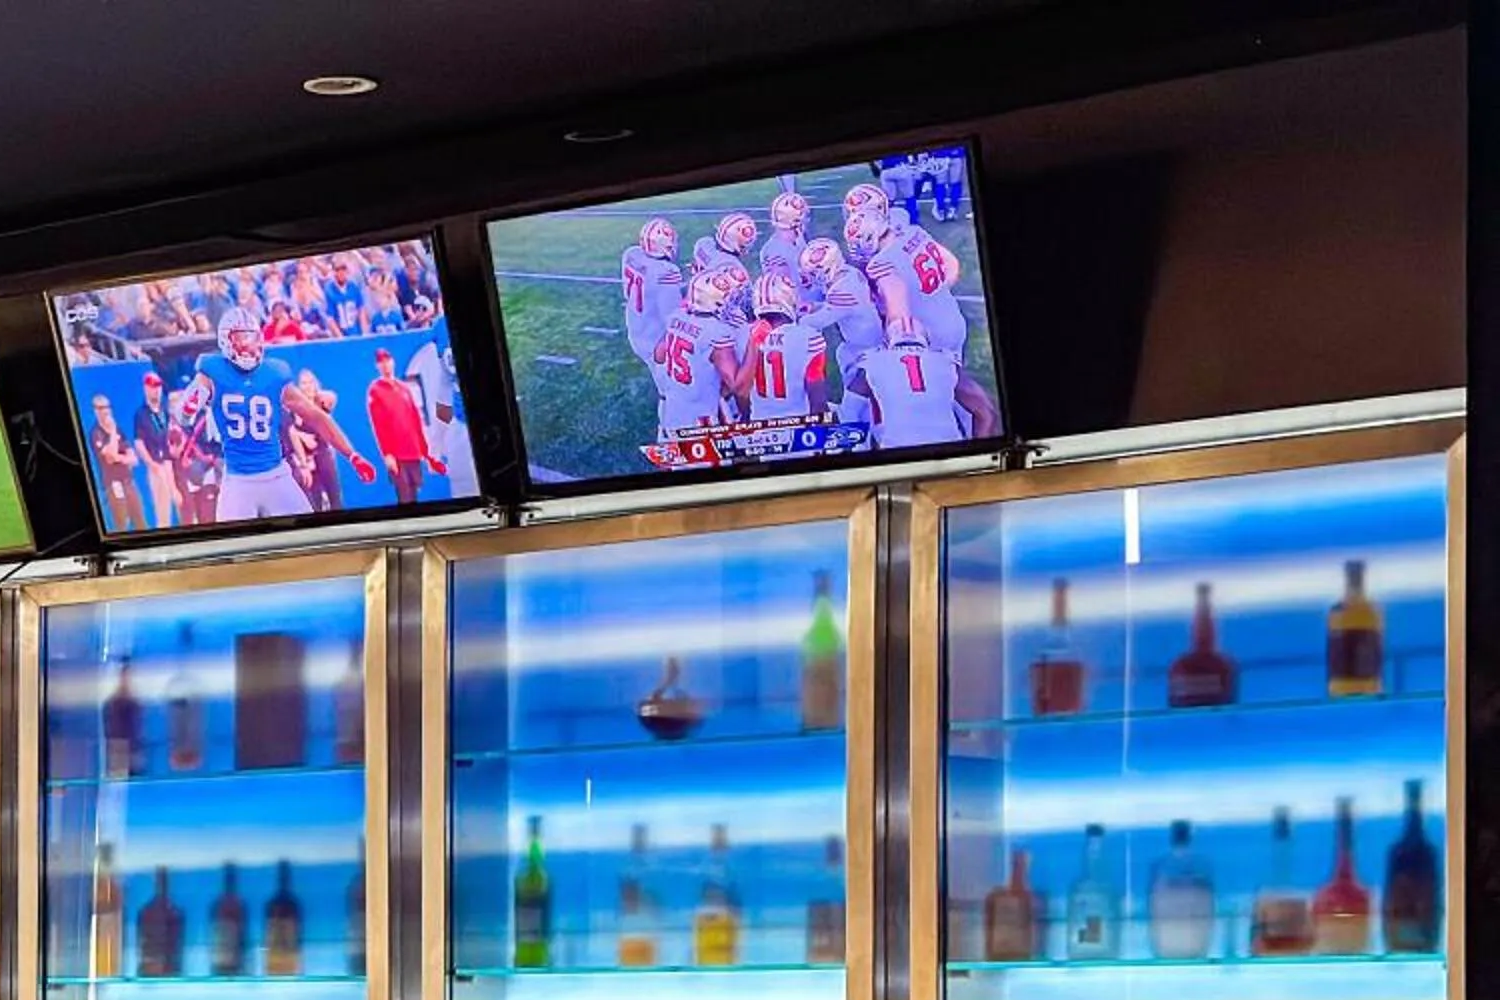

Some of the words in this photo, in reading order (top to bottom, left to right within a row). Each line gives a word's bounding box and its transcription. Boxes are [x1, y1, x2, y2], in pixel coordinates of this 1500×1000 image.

[666, 332, 695, 385] 15
[900, 354, 926, 393] 1
[221, 393, 274, 441] 58
[691, 443, 706, 458] 0
[801, 431, 817, 446] 0
